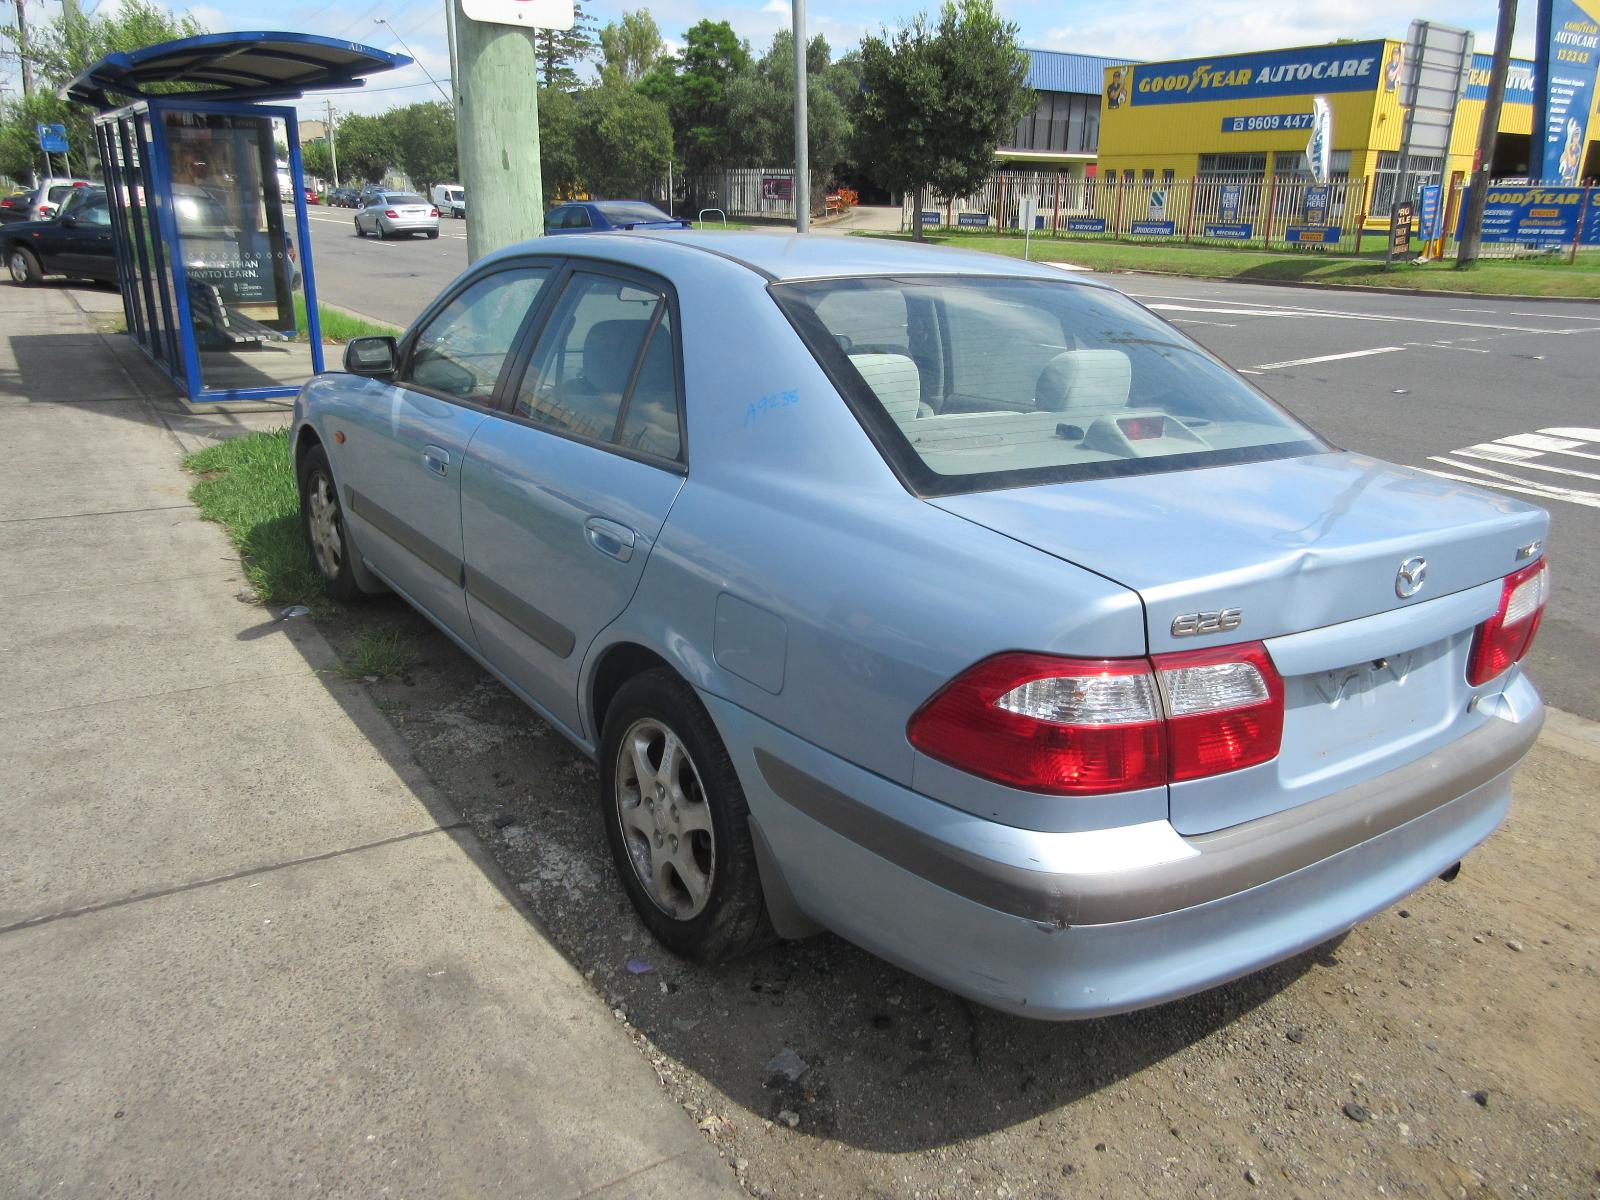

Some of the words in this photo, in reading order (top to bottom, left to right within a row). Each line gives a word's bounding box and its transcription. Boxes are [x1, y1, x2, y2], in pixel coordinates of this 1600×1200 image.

[1553, 32, 1598, 48] AUTOCARE
[1139, 65, 1253, 94] GOODYEAR
[1256, 58, 1376, 84] AUTOCARE
[1247, 117, 1279, 130] 9609
[1308, 193, 1327, 201] SOLD
[1487, 189, 1581, 208] OODYEAR
[231, 260, 259, 269] THAN
[209, 270, 222, 279] TO
[223, 270, 260, 279] LEARN.
[1170, 607, 1243, 638] 626
